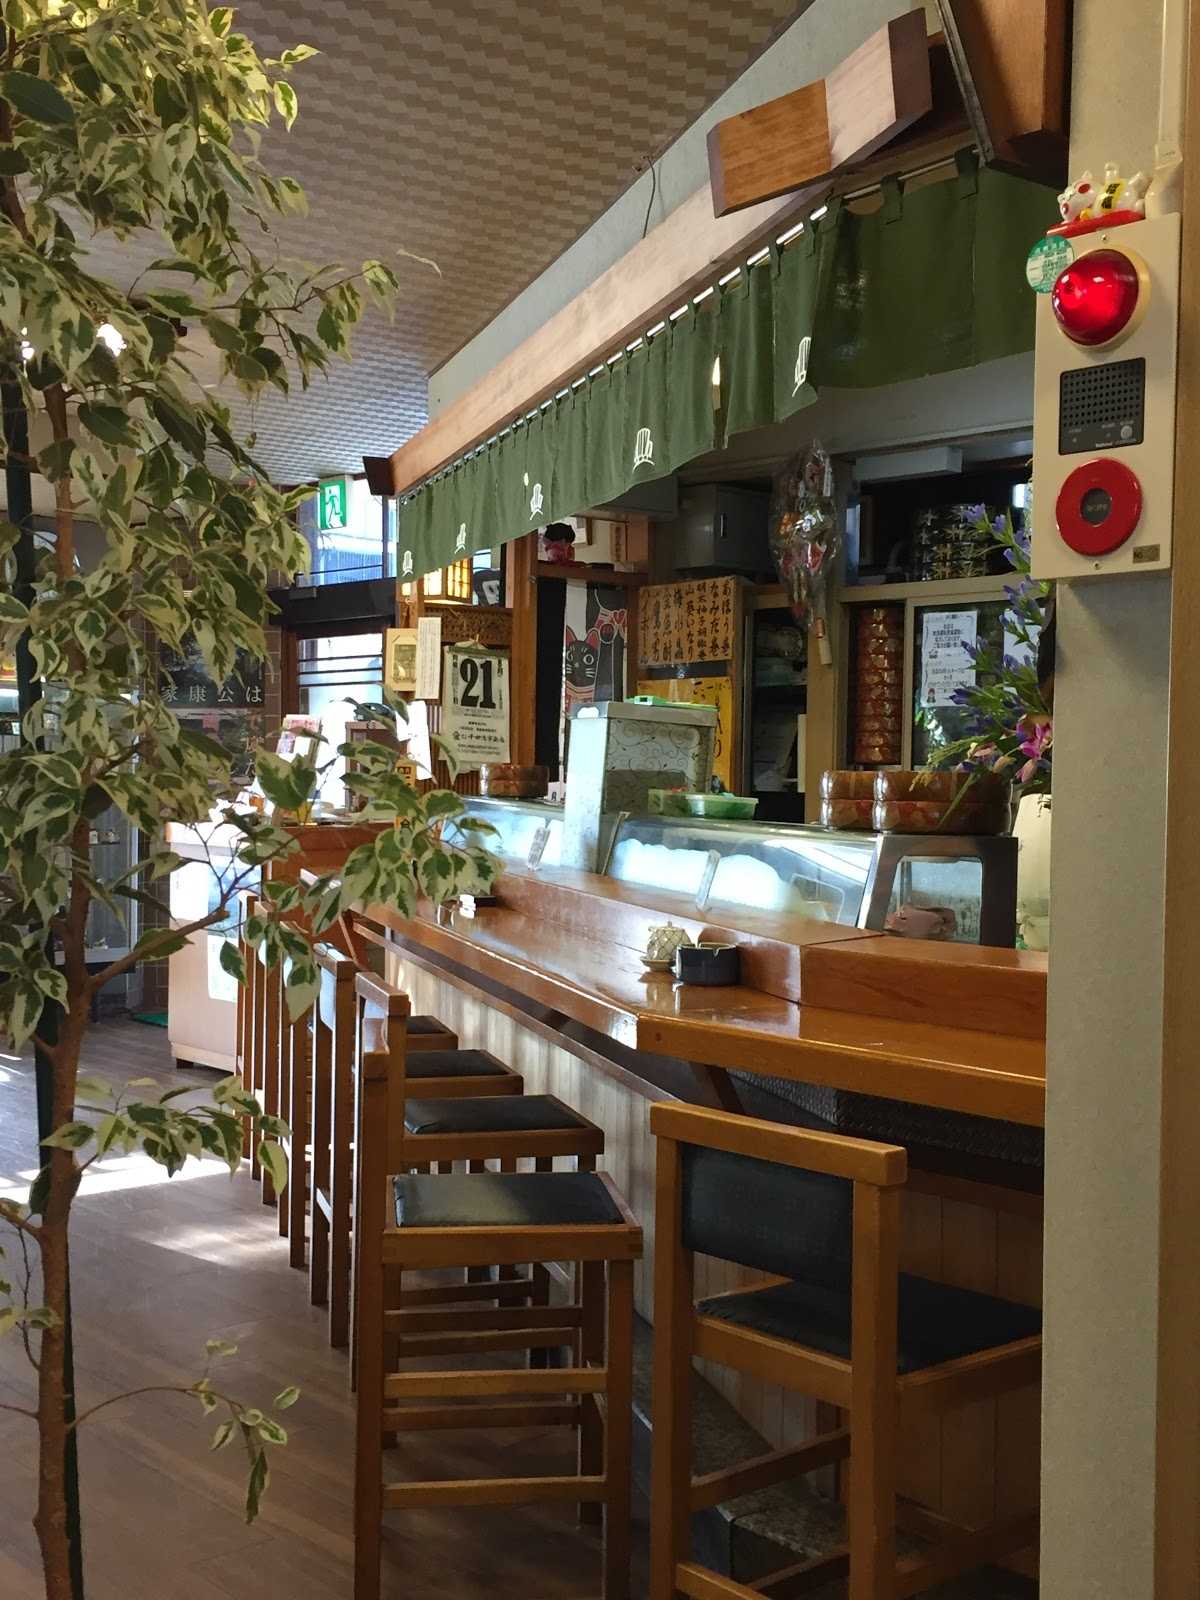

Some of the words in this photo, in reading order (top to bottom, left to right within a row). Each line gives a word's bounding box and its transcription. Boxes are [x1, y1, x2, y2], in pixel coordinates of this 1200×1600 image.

[161, 685, 263, 703] 家康公は
[460, 658, 496, 709] 21
